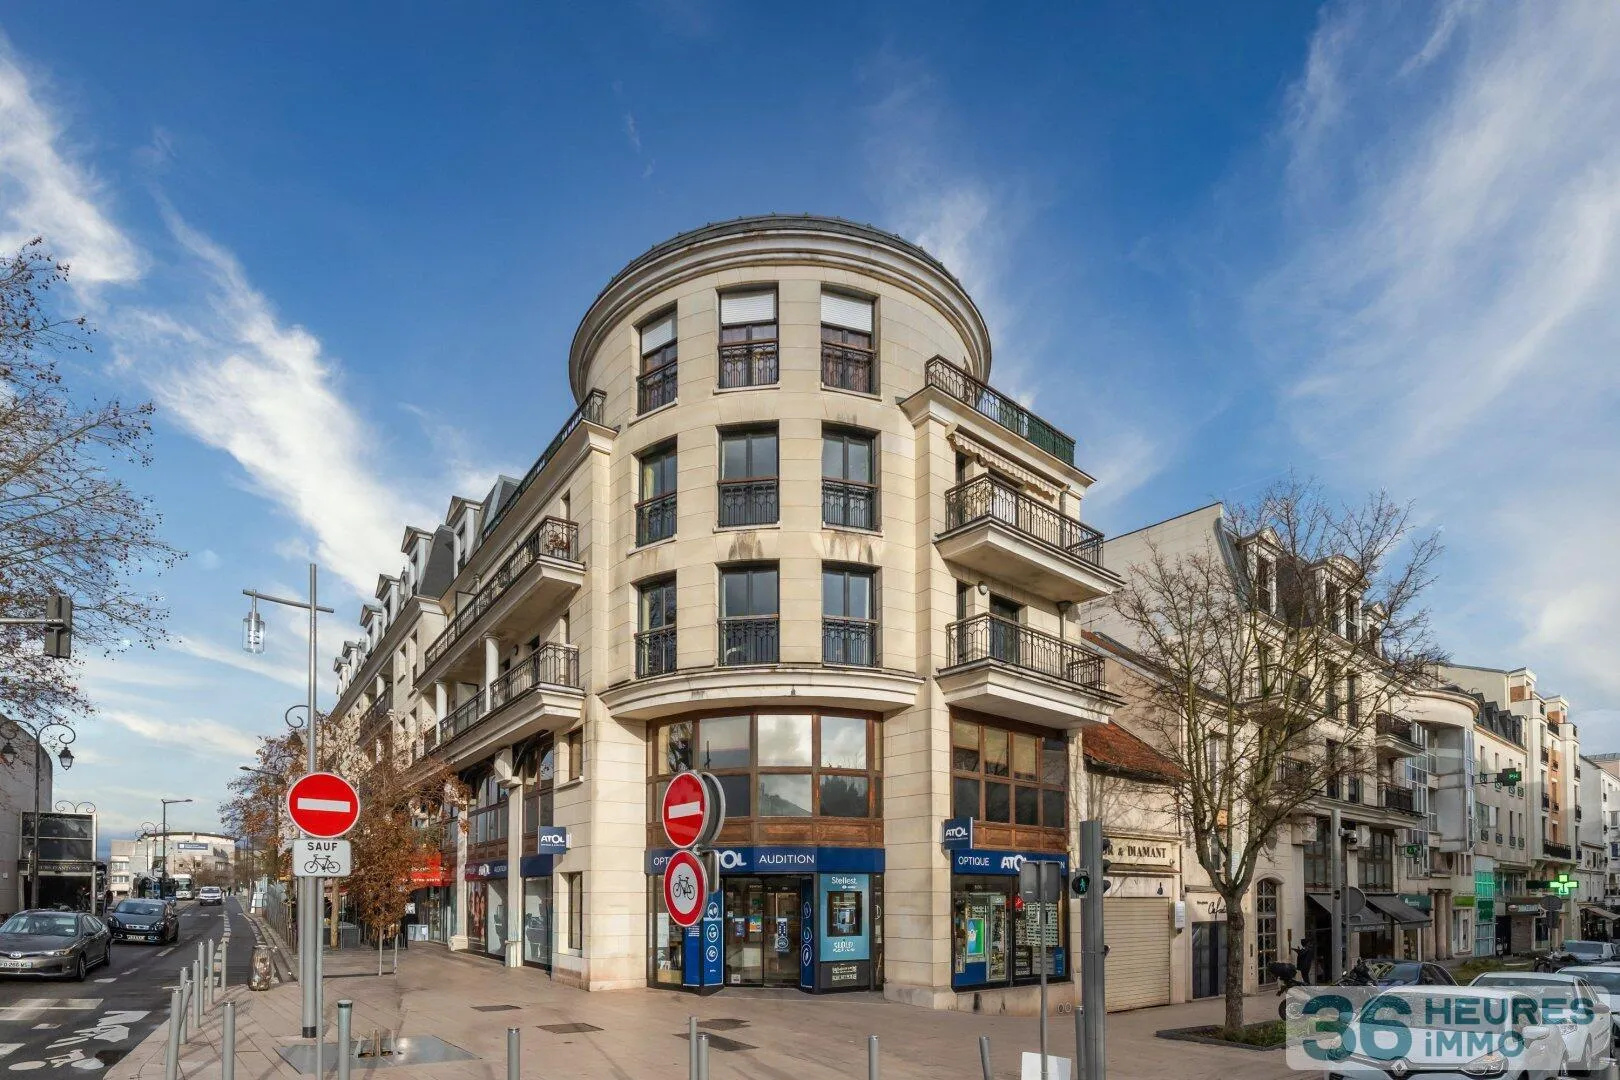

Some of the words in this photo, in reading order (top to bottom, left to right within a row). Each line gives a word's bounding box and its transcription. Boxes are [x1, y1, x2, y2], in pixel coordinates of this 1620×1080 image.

[945, 826, 968, 837] ATOL
[541, 834, 565, 844] ATOL
[307, 842, 338, 851] SAUF
[1127, 846, 1167, 859] DIAMANT
[758, 854, 815, 864] AUDITION
[958, 856, 990, 867] OPTIQUE
[1001, 854, 1026, 872] ATO
